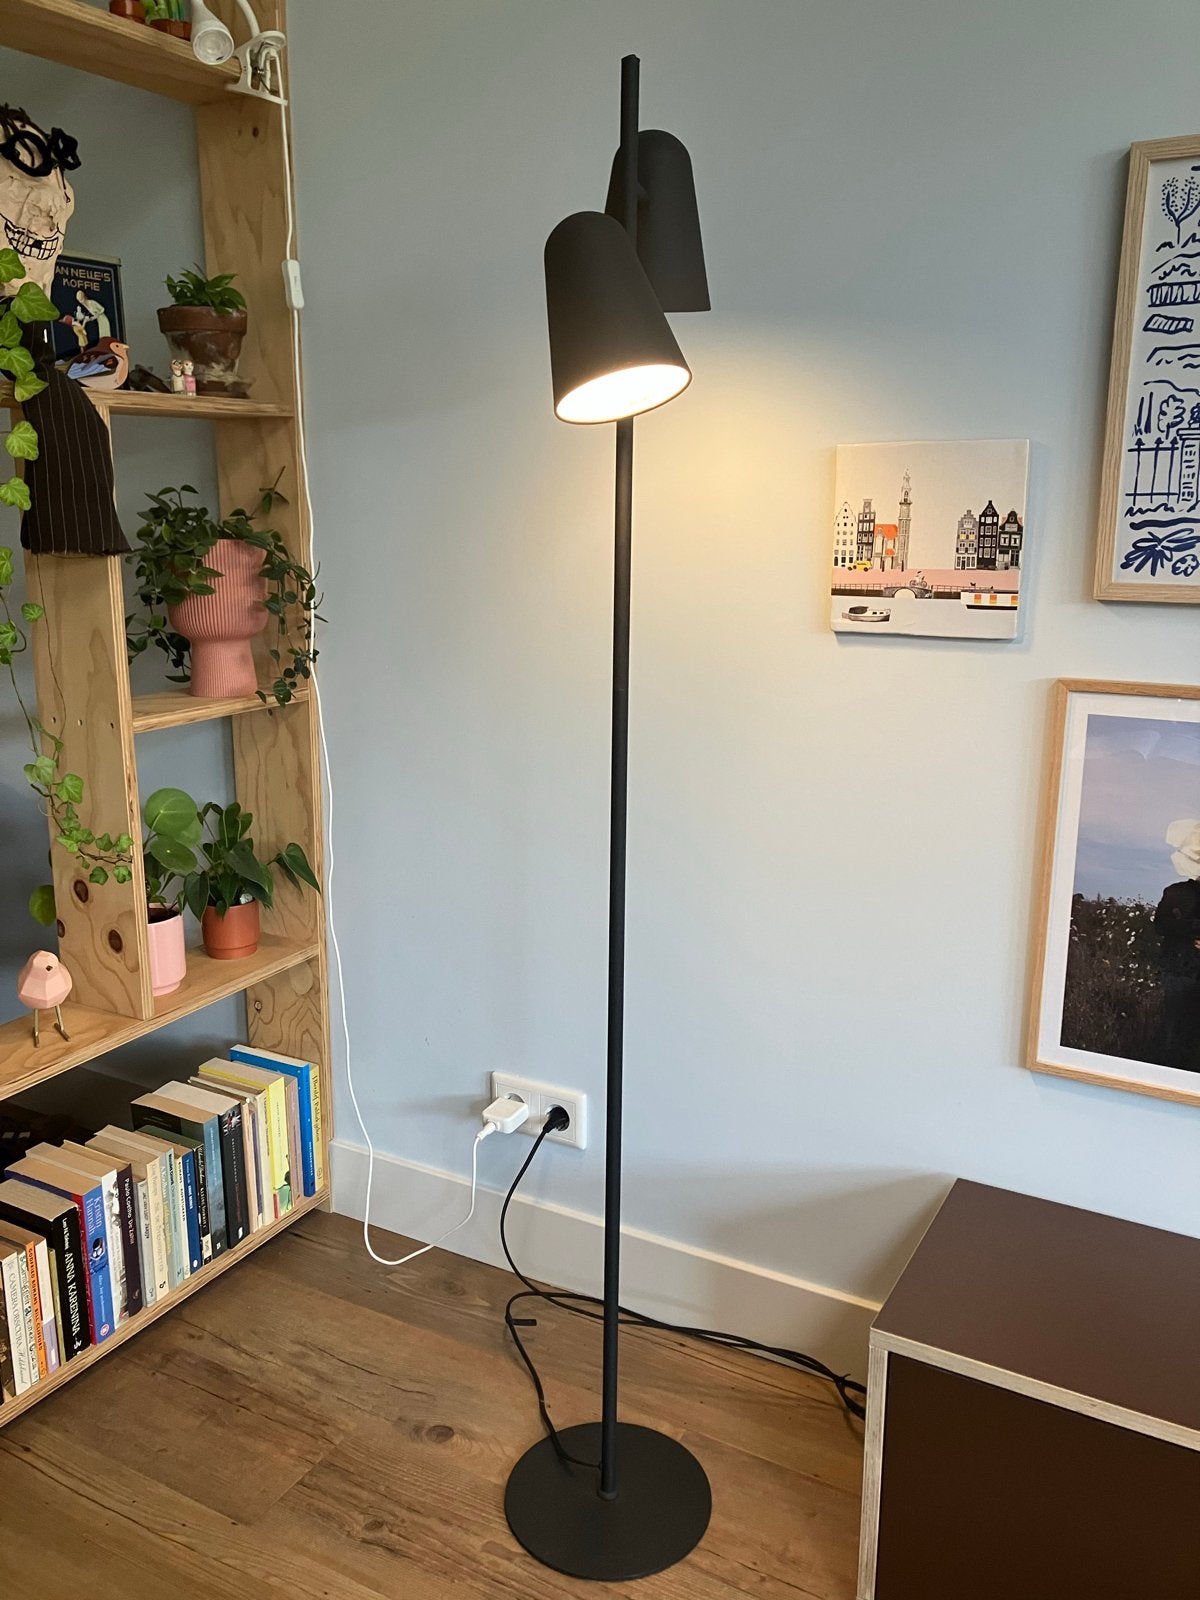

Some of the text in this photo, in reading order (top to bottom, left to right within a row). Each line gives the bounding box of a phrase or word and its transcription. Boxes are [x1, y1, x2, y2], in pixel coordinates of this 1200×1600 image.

[55, 266, 69, 276] AN
[63, 278, 100, 291] KOFFIE
[85, 1197, 96, 1236] Hannah
[93, 1195, 103, 1228] Kristin
[8, 1271, 19, 1310] CAMERA
[64, 1250, 80, 1336] ANNA KARENINA
[12, 1307, 23, 1349] OBSCURA
